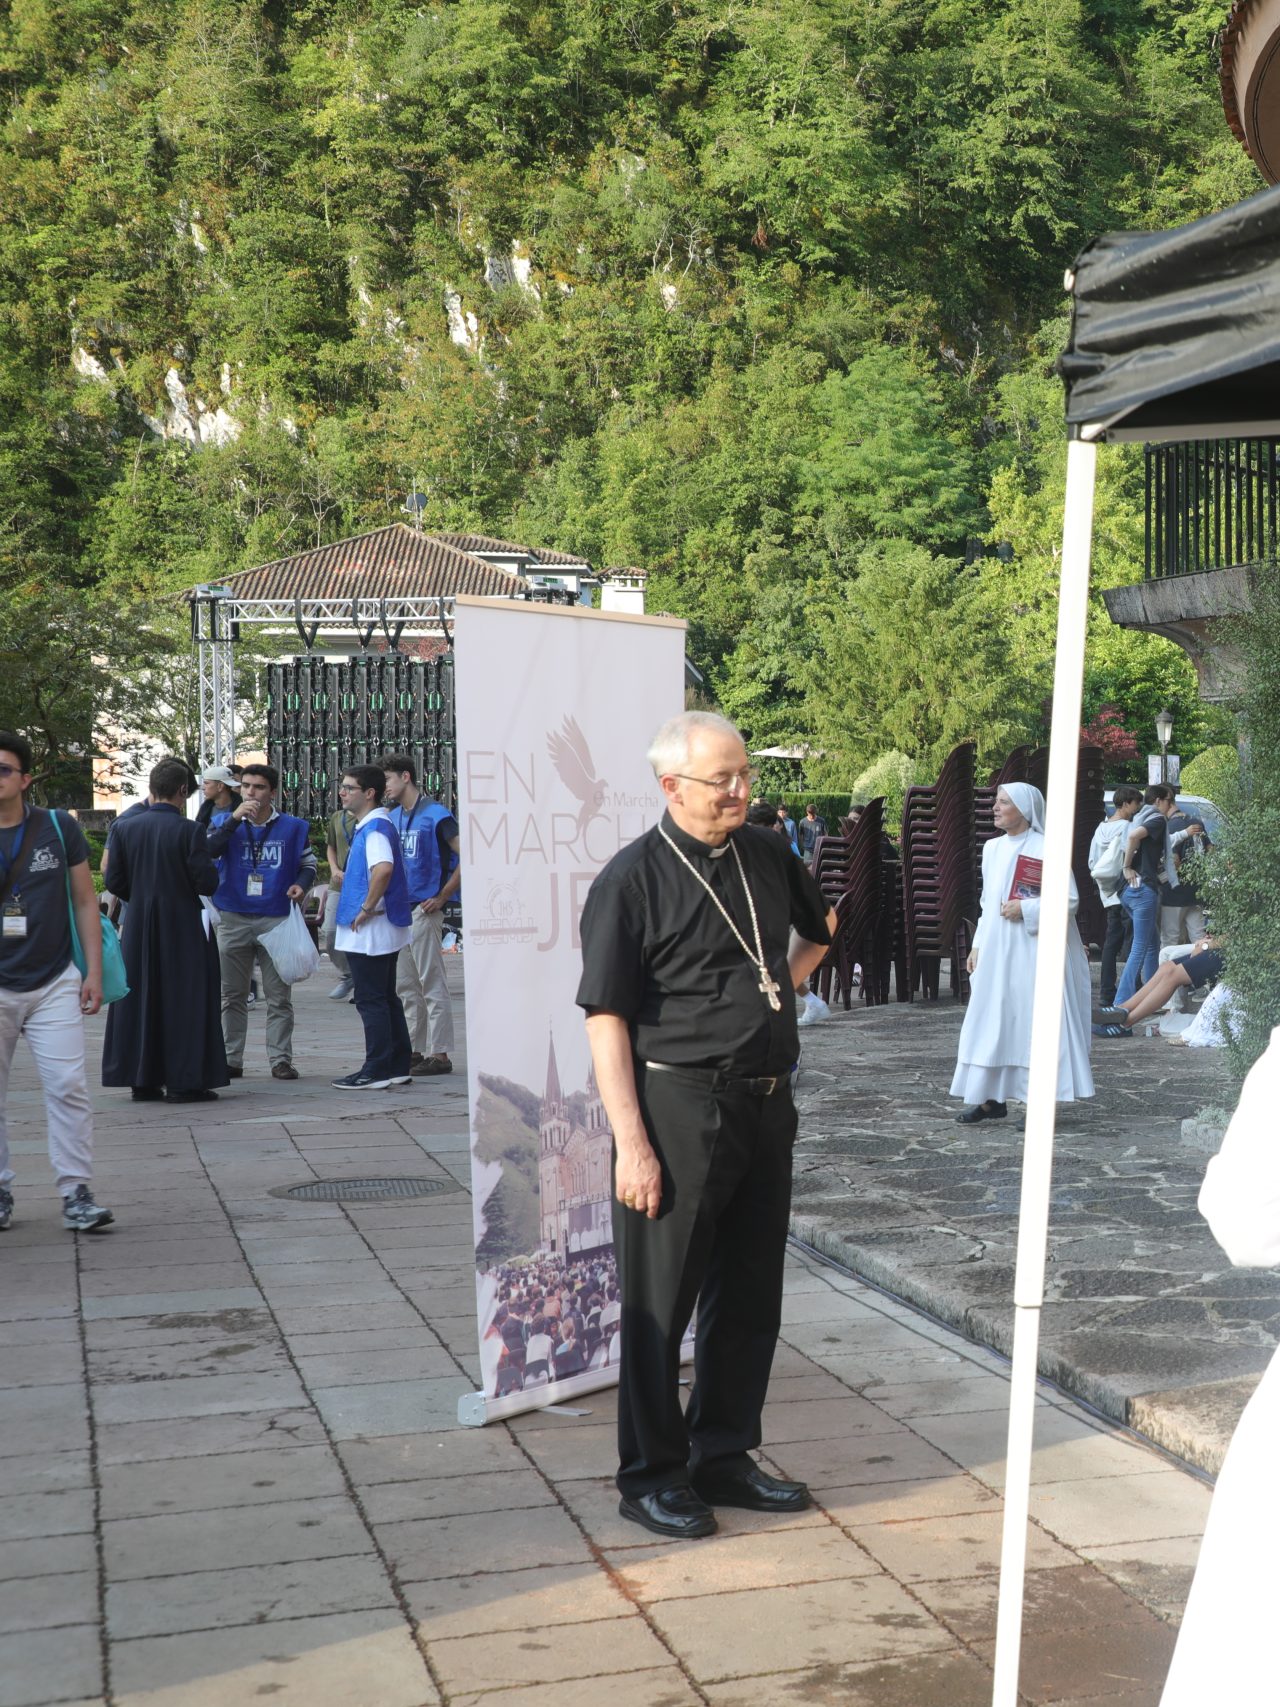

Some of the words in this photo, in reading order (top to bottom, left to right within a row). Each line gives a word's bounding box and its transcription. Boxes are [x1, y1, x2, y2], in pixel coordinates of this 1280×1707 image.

[466, 751, 536, 804] EN
[613, 792, 659, 808] Marcha
[469, 813, 645, 865] MARCH
[537, 872, 598, 951] JE
